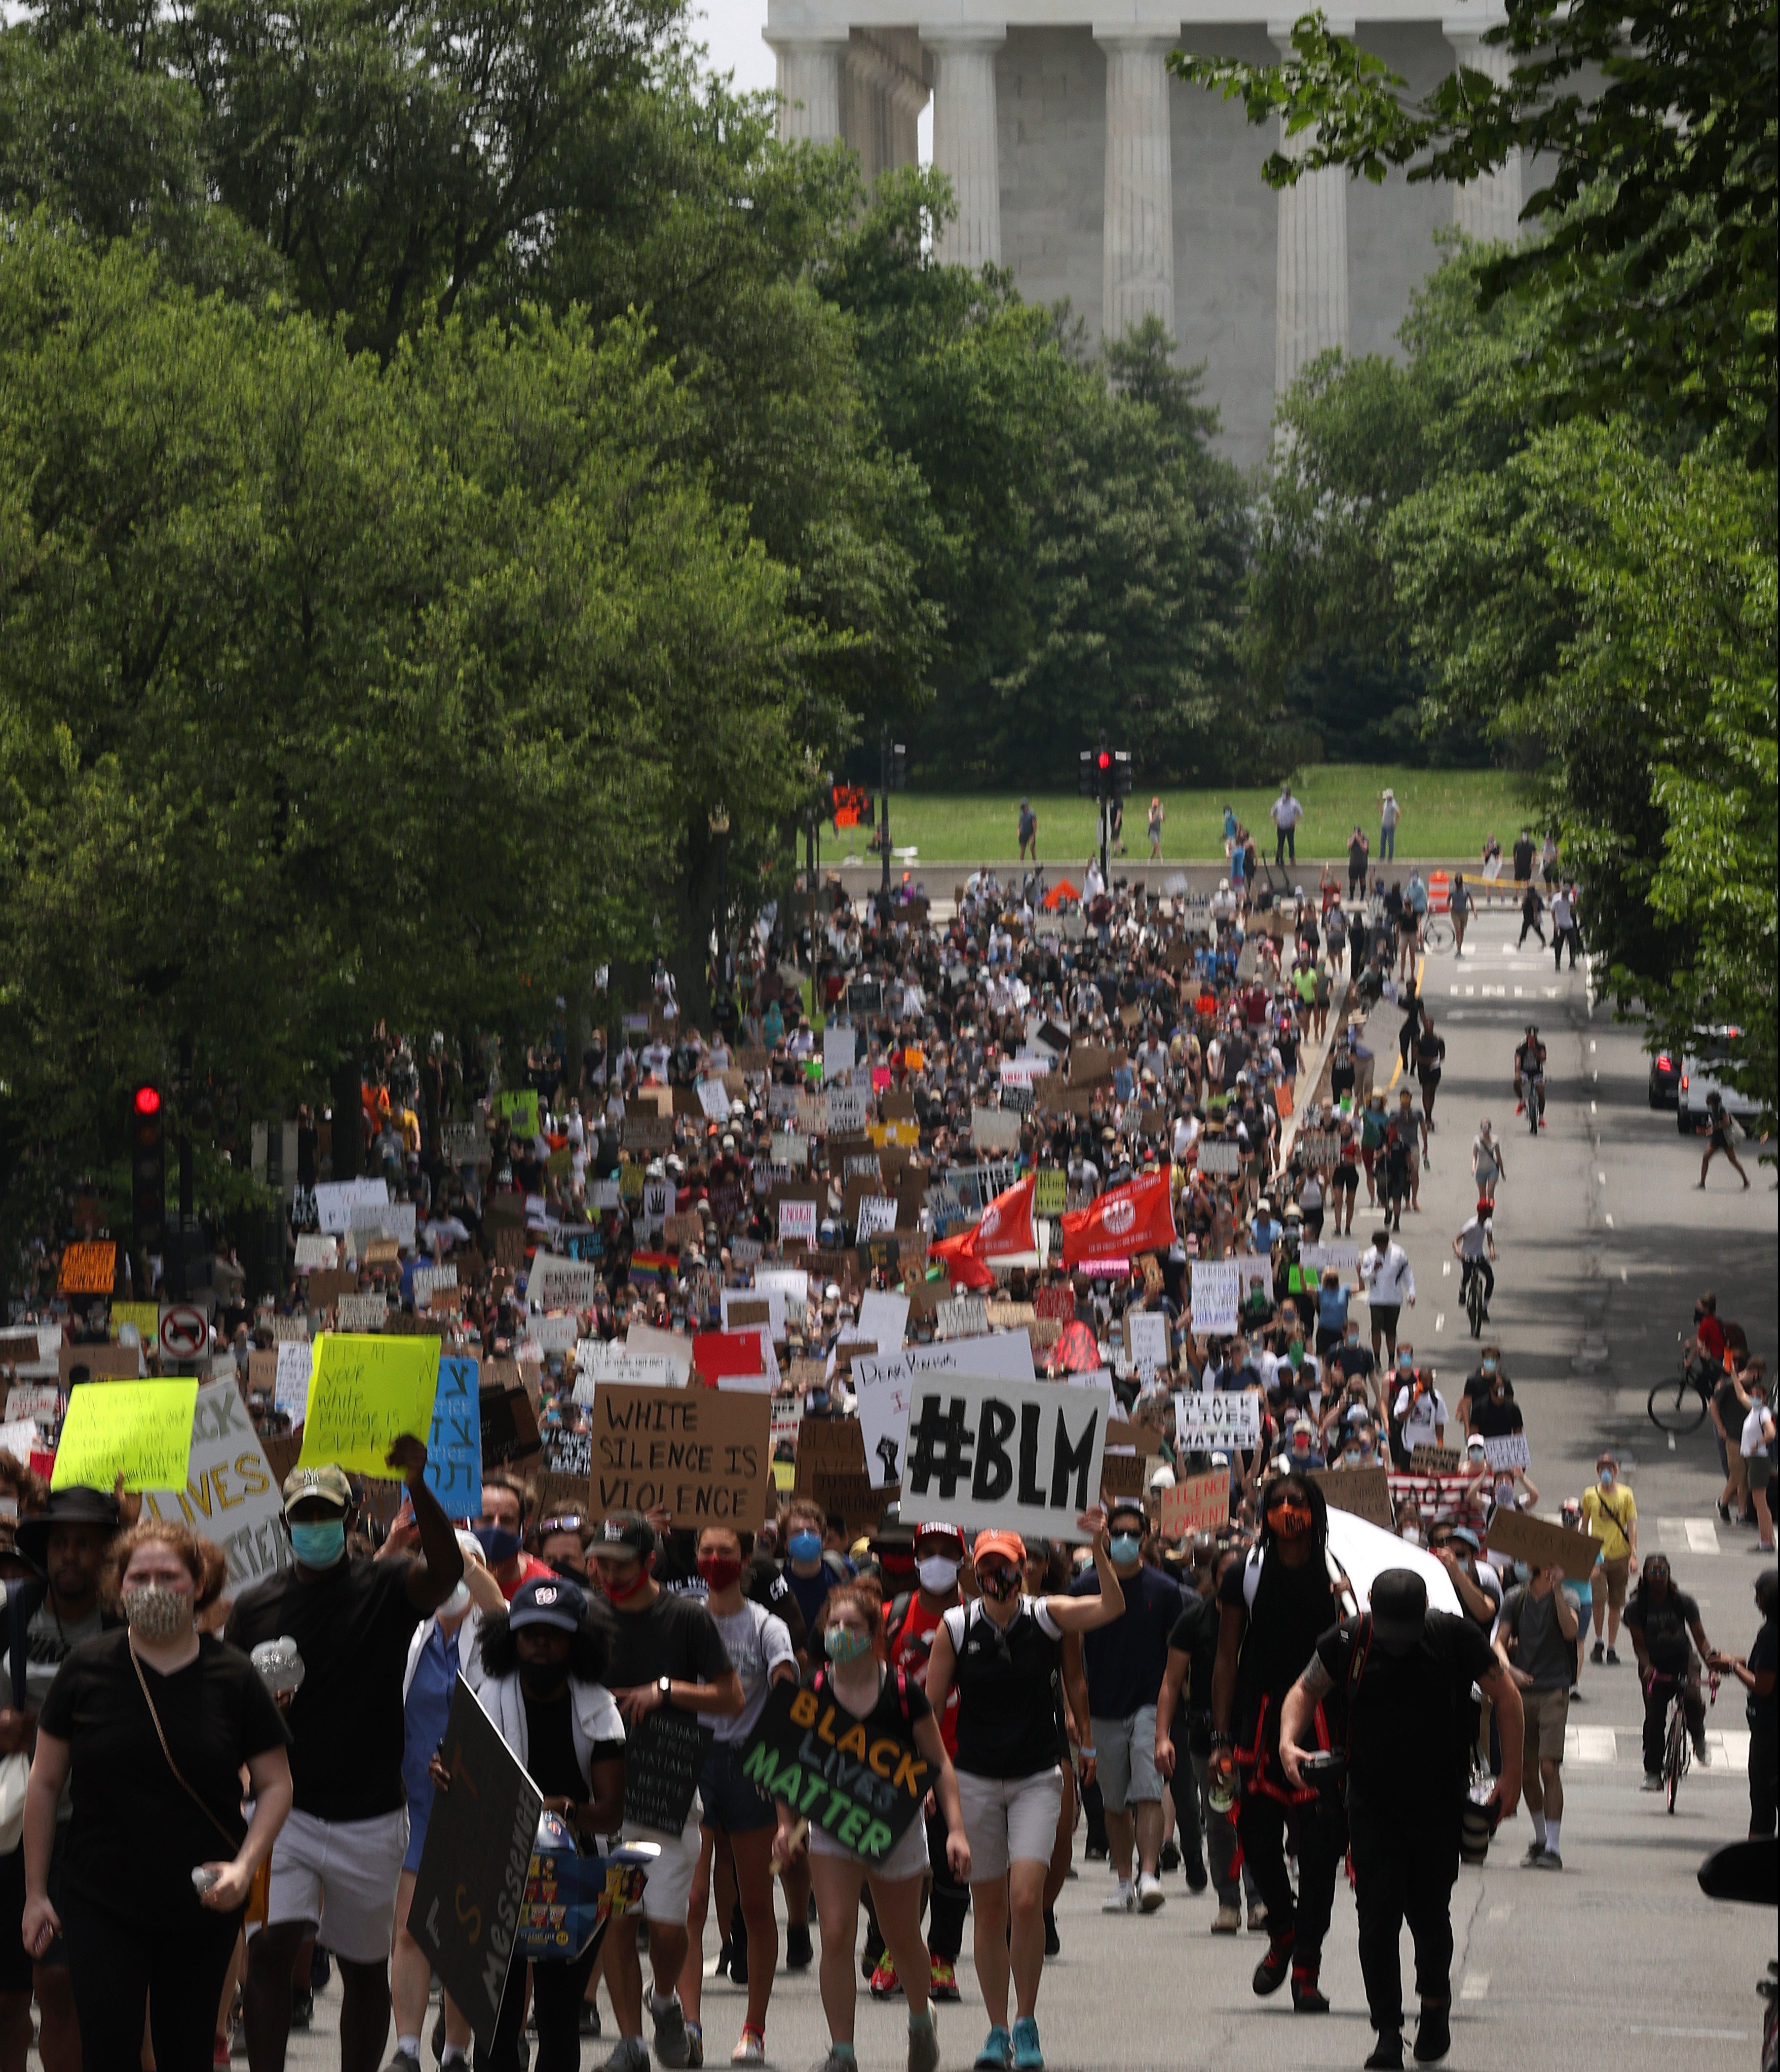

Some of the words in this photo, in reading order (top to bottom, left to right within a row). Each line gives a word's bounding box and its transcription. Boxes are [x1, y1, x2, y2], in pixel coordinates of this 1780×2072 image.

[606, 1394, 698, 1432] WHITE
[1182, 1393, 1252, 1409] BLACK
[1186, 1409, 1252, 1423] LIVES
[600, 1435, 713, 1472] SILENCE
[725, 1444, 758, 1480] IS
[907, 1393, 1100, 1511] #BLM
[1180, 1431, 1257, 1448] MATTER
[600, 1475, 749, 1518] VIOLENCE
[1163, 1475, 1226, 1508] SILENCE
[789, 1687, 928, 1798] BLACK
[798, 1729, 899, 1812] LIVES
[742, 1740, 893, 1858] MATTER
